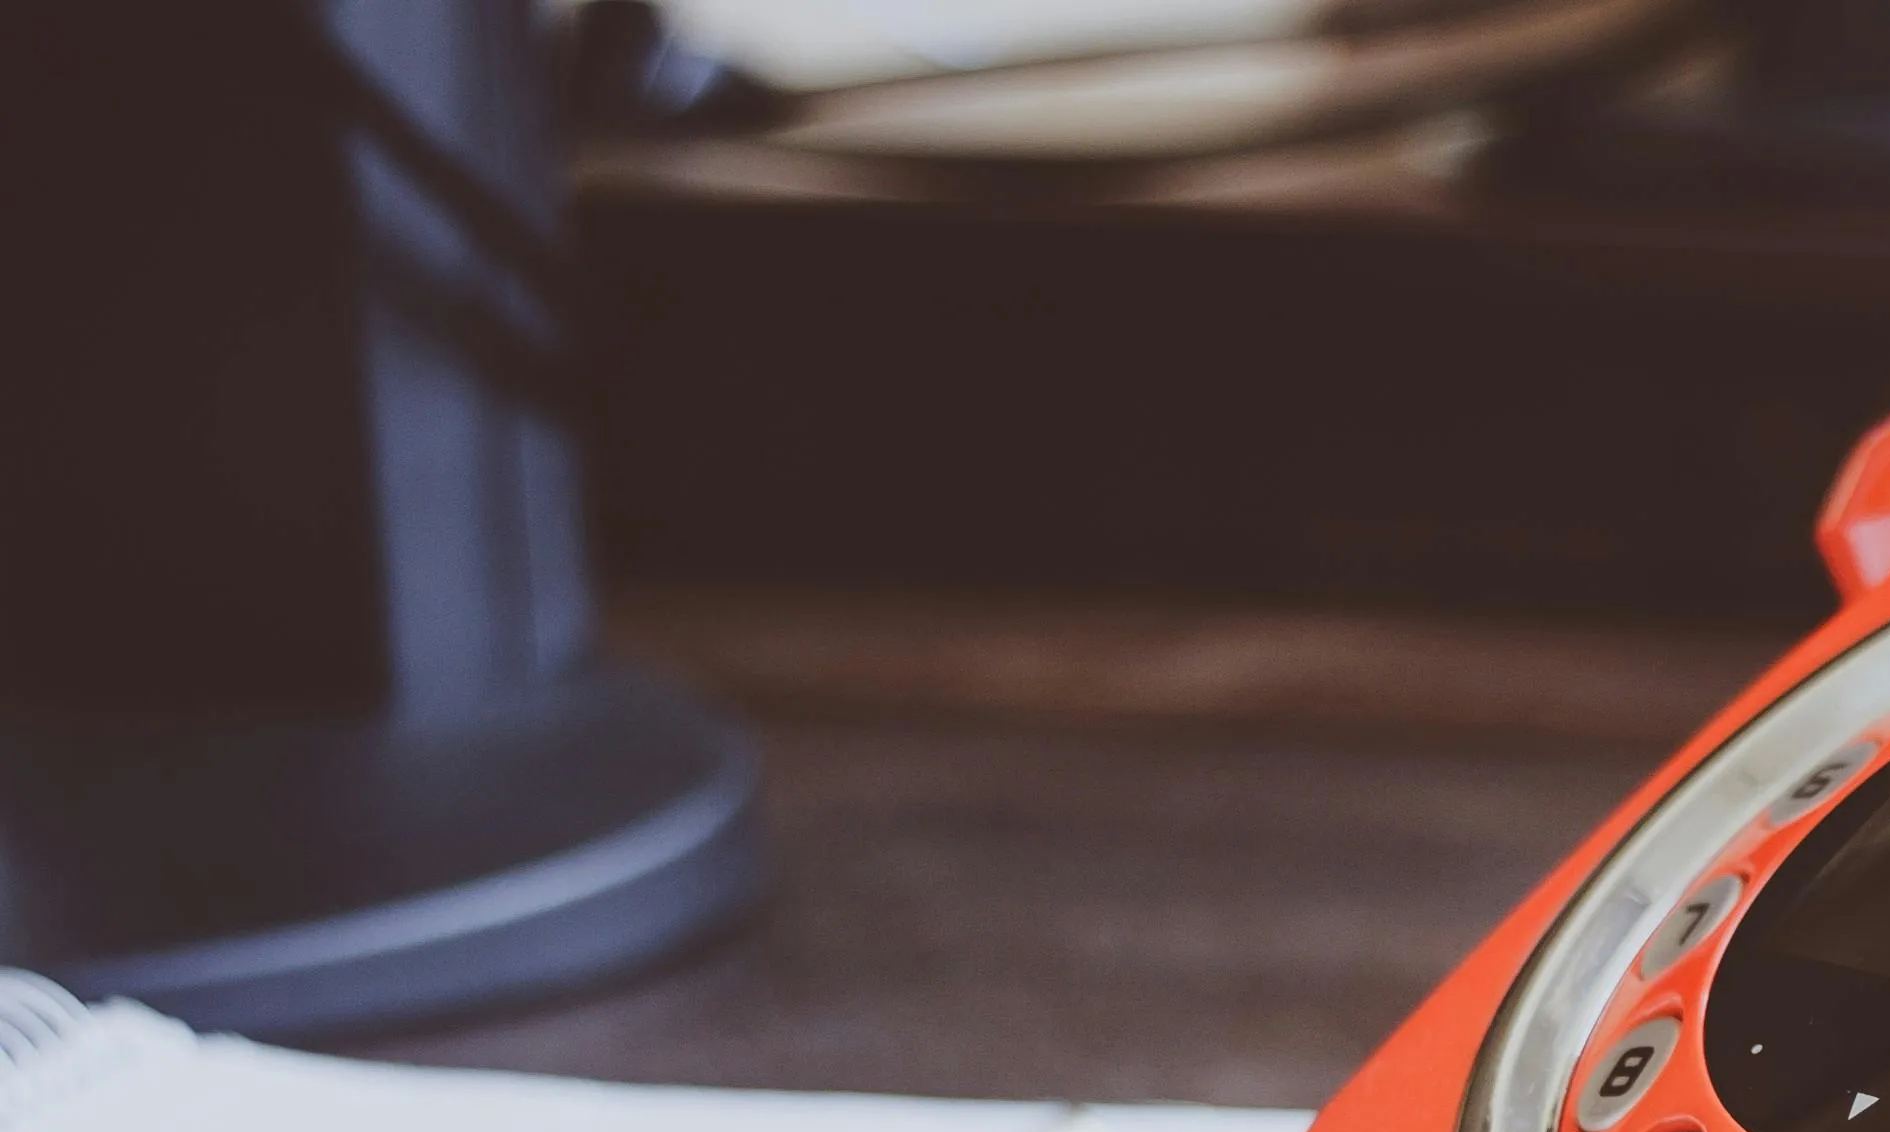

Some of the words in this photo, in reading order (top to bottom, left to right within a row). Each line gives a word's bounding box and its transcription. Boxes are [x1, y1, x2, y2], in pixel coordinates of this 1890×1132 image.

[1791, 763, 1849, 799] 6
[1679, 902, 1710, 946] 7
[1599, 1046, 1655, 1098] 8
